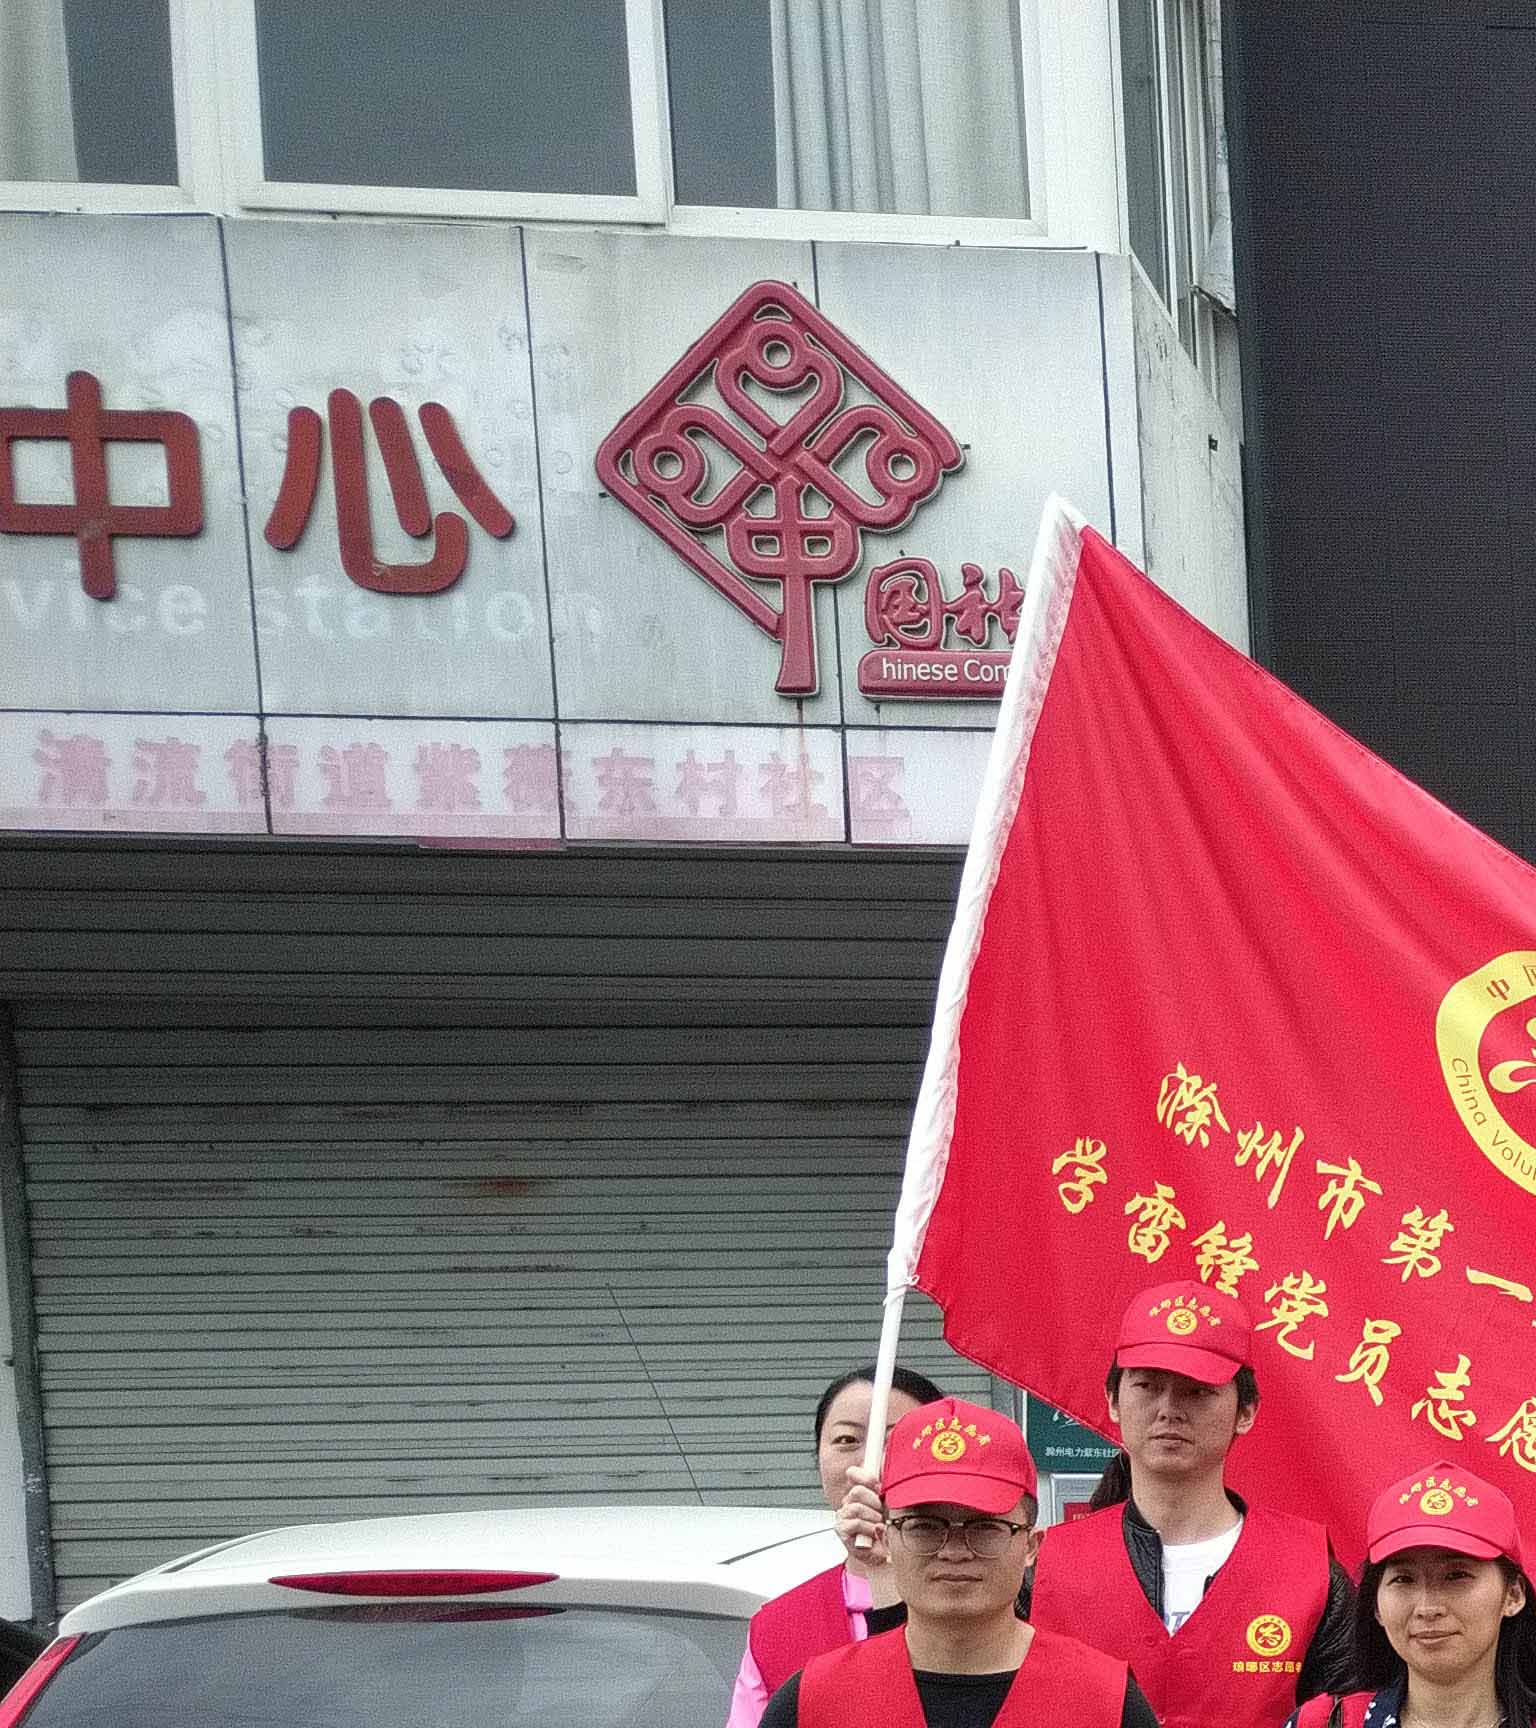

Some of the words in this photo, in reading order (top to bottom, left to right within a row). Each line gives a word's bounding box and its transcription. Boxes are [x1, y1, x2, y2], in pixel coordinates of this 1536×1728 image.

[0, 370, 514, 600] 中心
[882, 657, 958, 682] hinese
[1451, 1058, 1488, 1127] China
